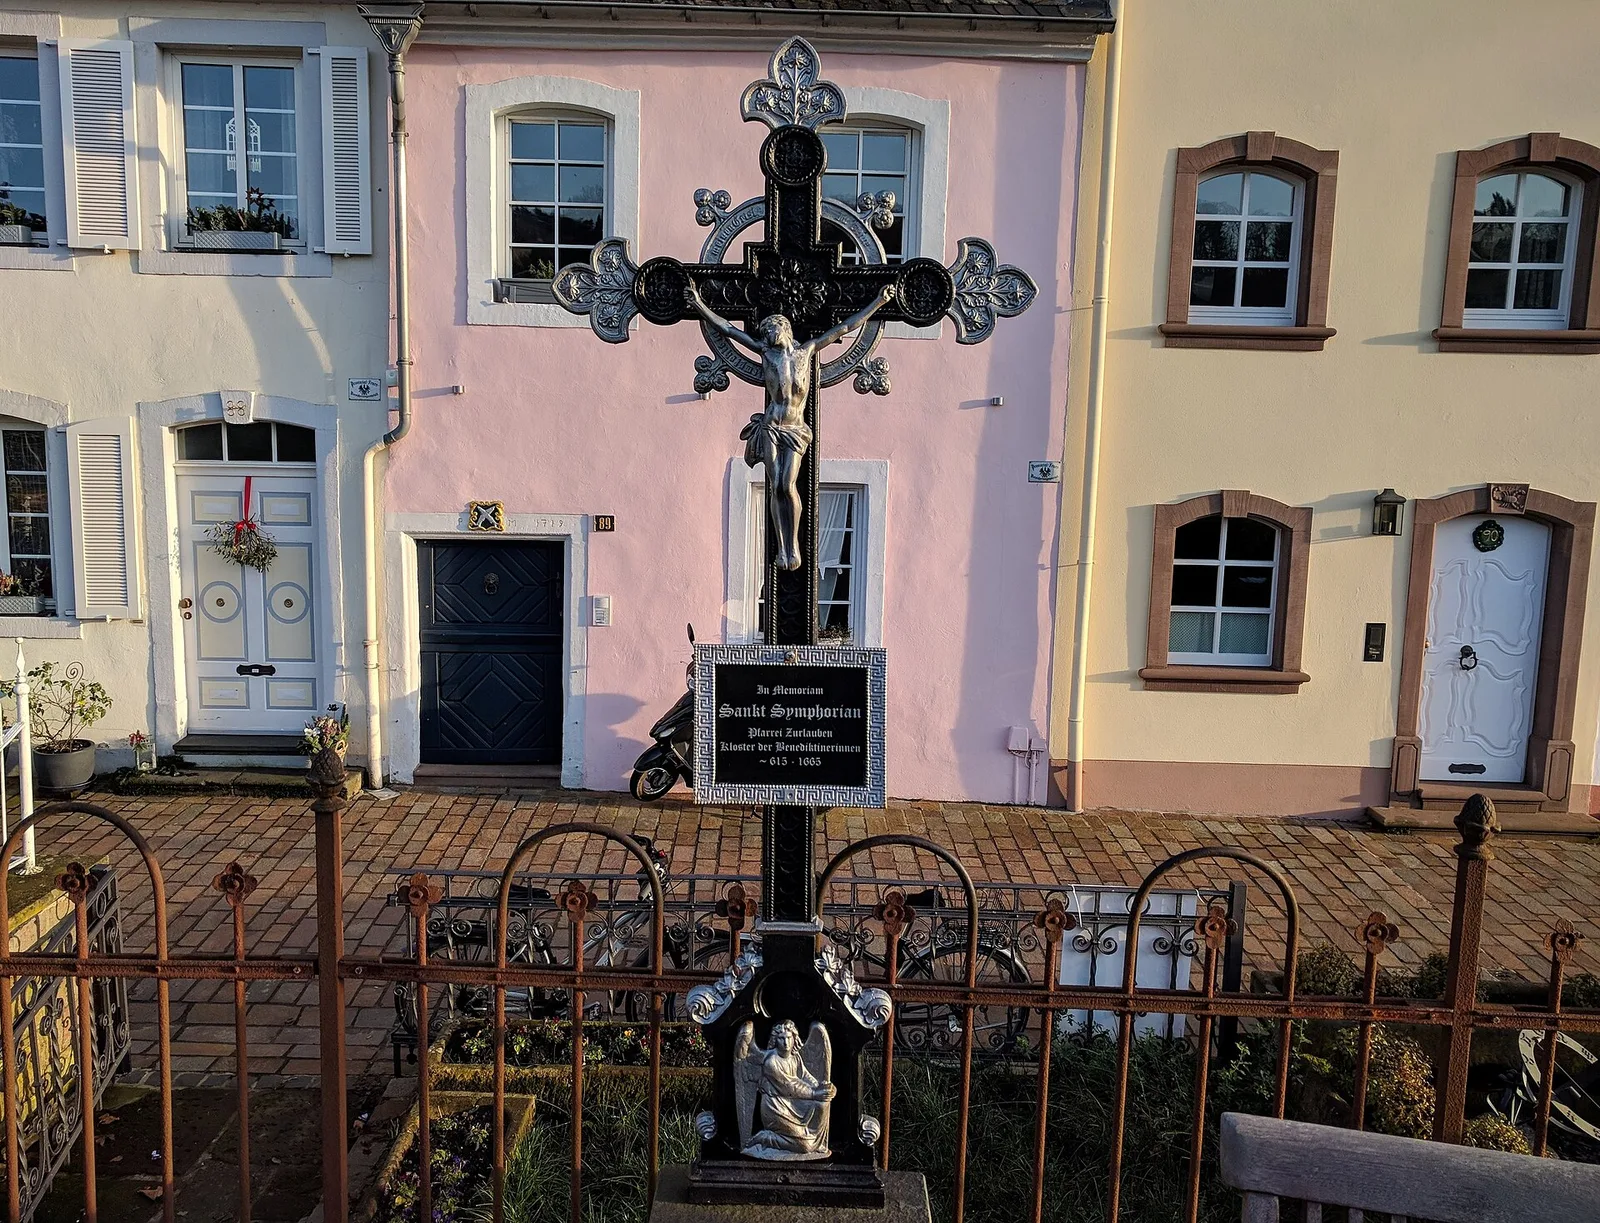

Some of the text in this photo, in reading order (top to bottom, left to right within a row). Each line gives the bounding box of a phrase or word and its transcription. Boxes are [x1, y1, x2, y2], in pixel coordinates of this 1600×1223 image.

[599, 516, 611, 530] 89
[1483, 529, 1499, 542] 90
[756, 684, 824, 696] In Memoriam
[718, 703, 862, 721] Sankt Symphorian
[747, 727, 833, 739] Pfarrei Zurlauben
[719, 741, 861, 753] Kloster der Benediktinerinnen
[769, 756, 788, 766] 615
[799, 757, 822, 766] 1665
